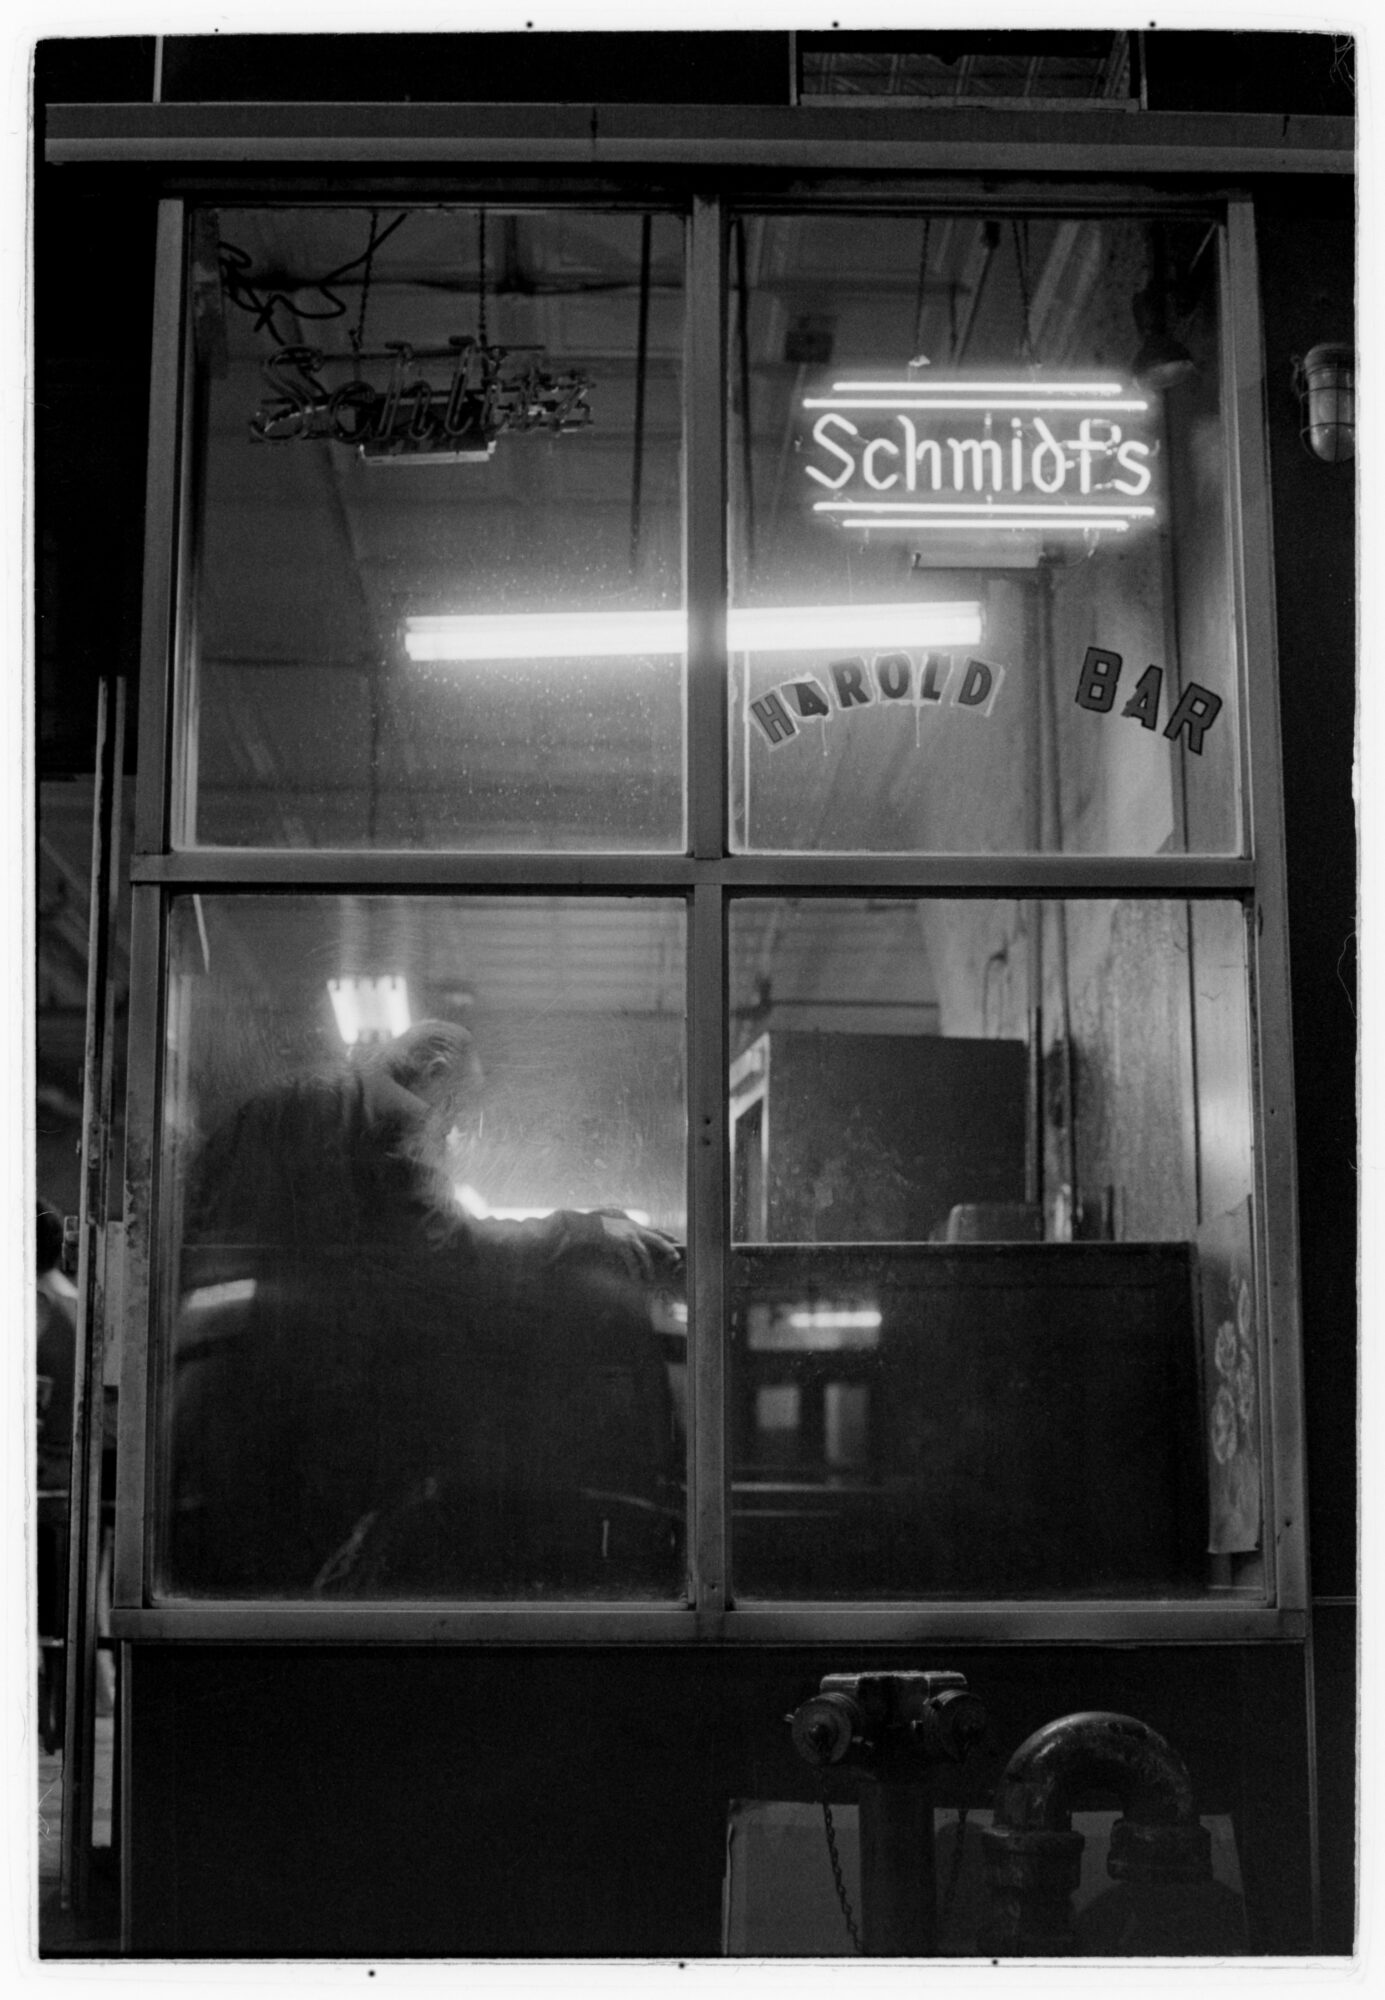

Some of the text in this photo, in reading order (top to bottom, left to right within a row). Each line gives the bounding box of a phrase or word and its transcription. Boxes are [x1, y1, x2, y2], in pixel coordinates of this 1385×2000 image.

[805, 412, 1153, 496] Schmidt's
[750, 646, 1223, 755] HAROLD BAR
